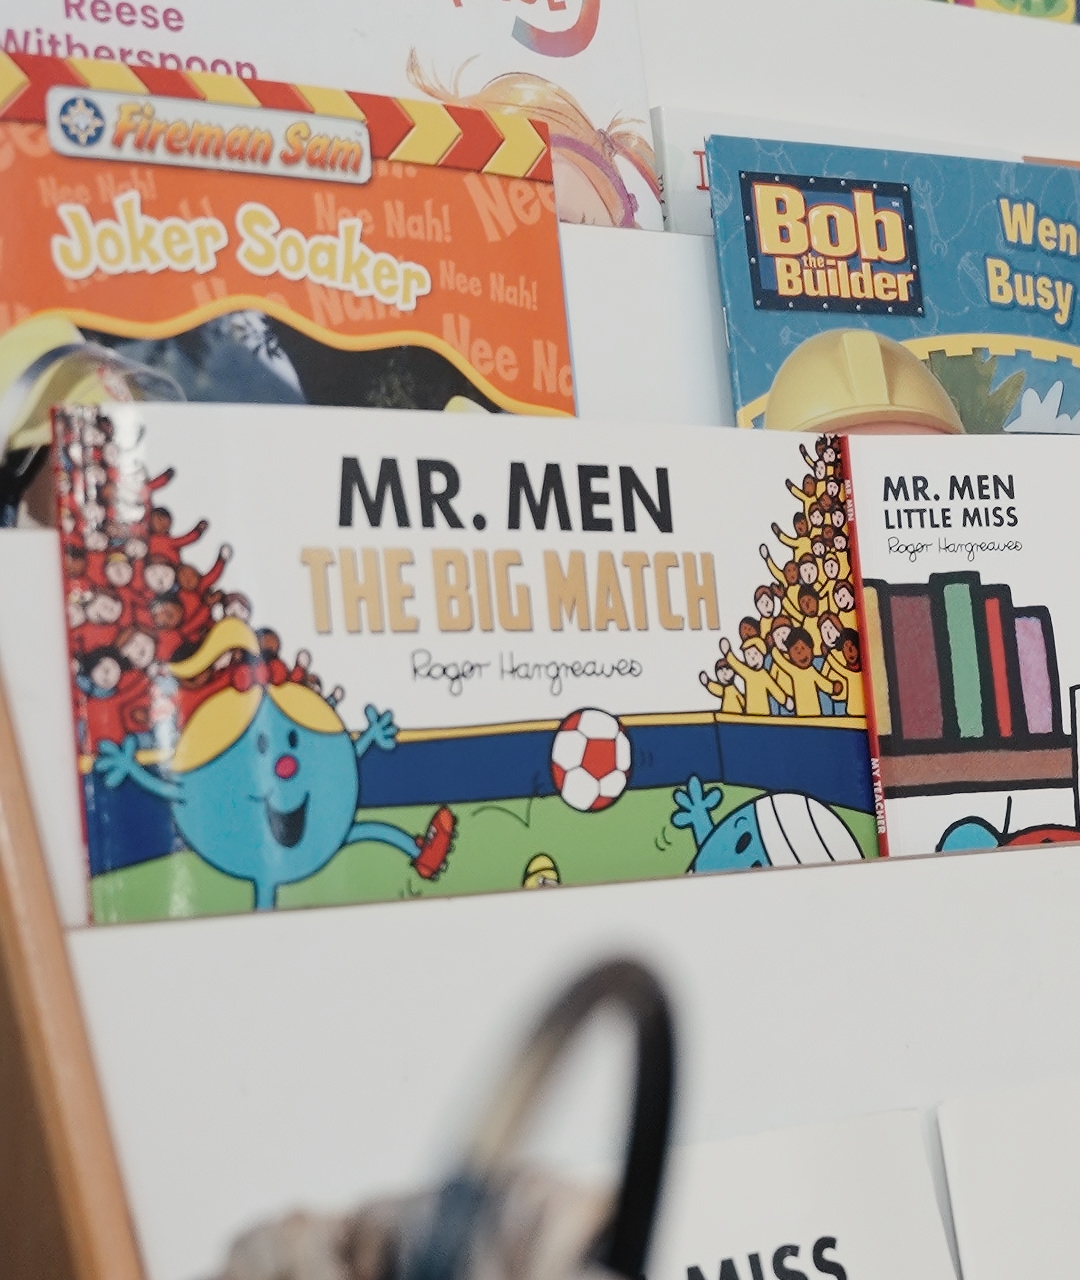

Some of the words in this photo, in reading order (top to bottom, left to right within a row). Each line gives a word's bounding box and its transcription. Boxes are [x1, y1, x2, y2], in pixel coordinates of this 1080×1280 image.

[112, 102, 274, 166] Fireman
[279, 121, 364, 177] Sam
[384, 198, 451, 243] Nah!
[752, 181, 908, 264] Bob
[51, 190, 228, 280] Joker
[235, 202, 431, 311] Soaker
[801, 252, 825, 270] the
[439, 260, 482, 297] Nee
[490, 272, 538, 311] Nah!
[774, 257, 914, 302] Builder
[986, 257, 1073, 327] Busy
[338, 456, 488, 531] MR.
[507, 462, 674, 533] MEN
[883, 476, 940, 502] MR.
[949, 475, 1015, 500] MEN
[884, 508, 952, 530] LITTLE
[962, 506, 1019, 528] MISS
[888, 536, 933, 563] Roger
[938, 537, 1023, 563] Hargreaves
[300, 547, 420, 634] THE
[431, 548, 533, 633] BIG
[543, 549, 720, 632] MATCH
[410, 648, 490, 697] Roger
[499, 651, 643, 697] Hargreaves
[870, 757, 880, 776] MY
[873, 781, 886, 834] TEACHER
